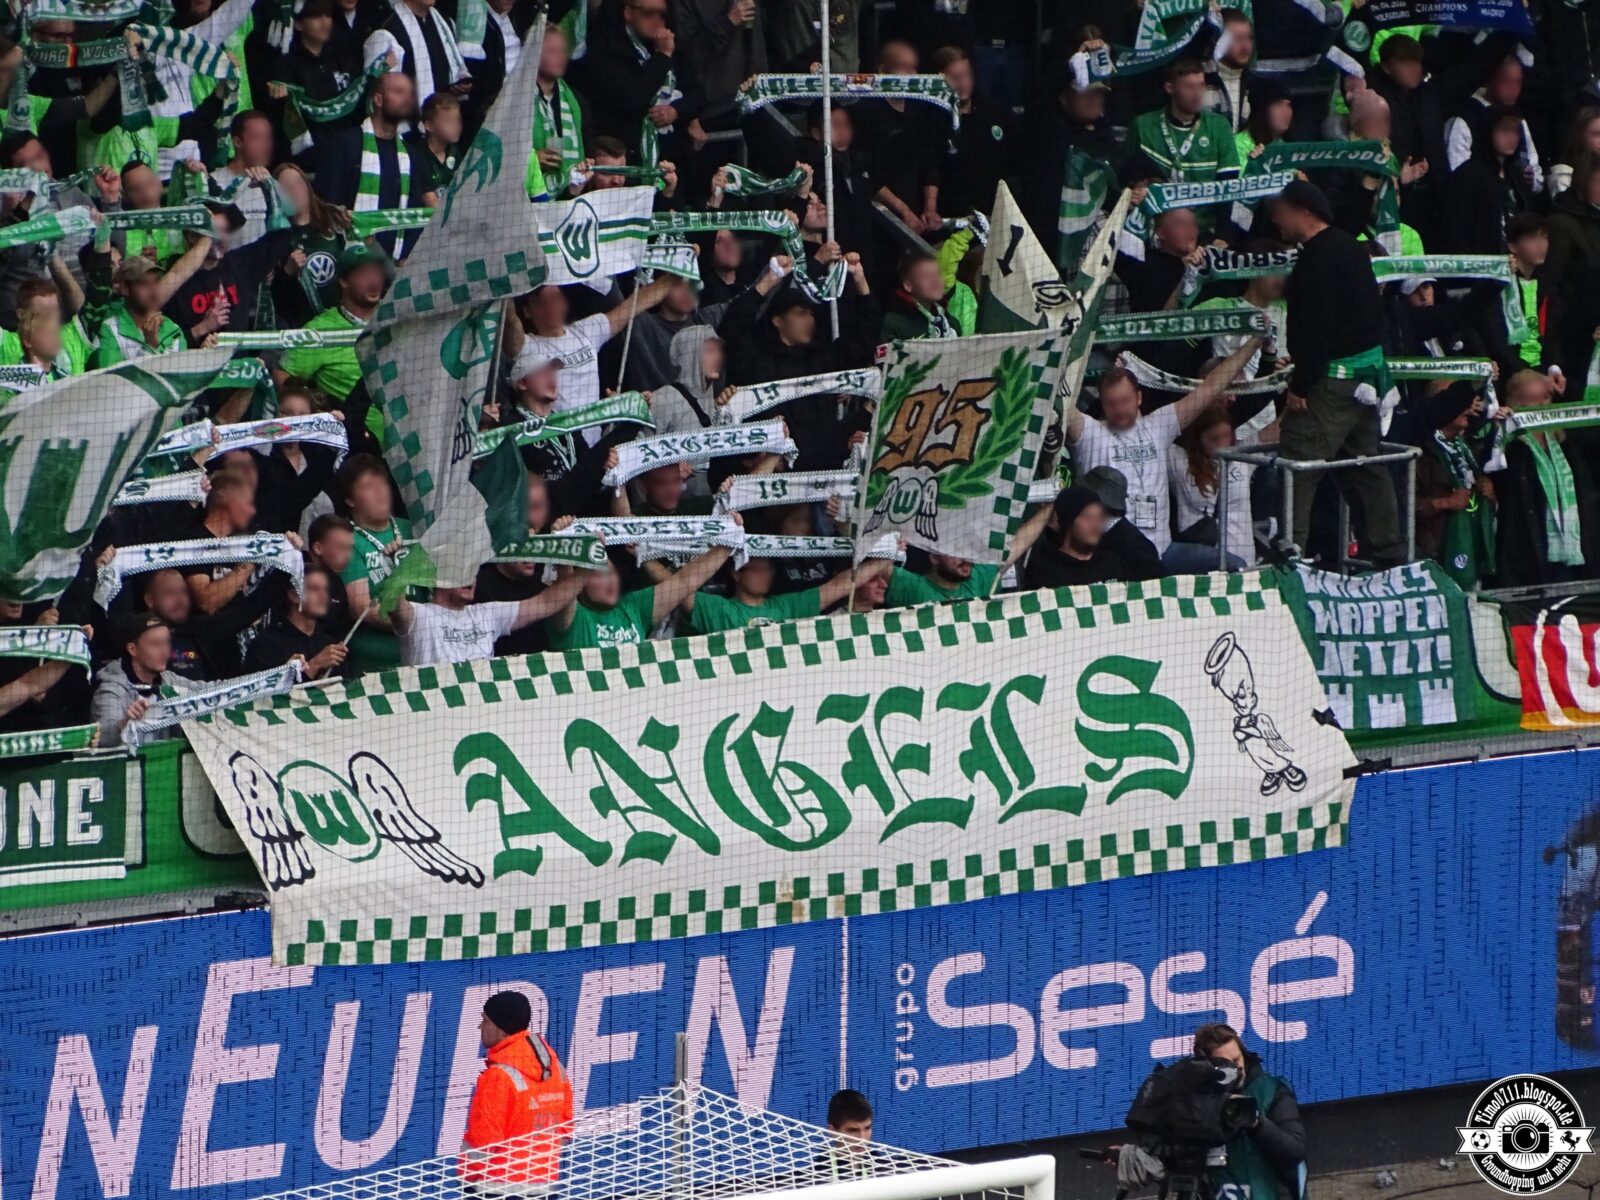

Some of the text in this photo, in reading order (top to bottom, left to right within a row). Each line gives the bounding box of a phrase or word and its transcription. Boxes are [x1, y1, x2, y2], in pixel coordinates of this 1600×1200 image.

[640, 428, 769, 465] ANGELS
[870, 377, 998, 474] 95
[573, 520, 726, 537] ANGELS
[1307, 594, 1448, 636] WAPPEN
[1316, 635, 1453, 677] JETZT!
[453, 657, 1196, 877] ANGELS
[0, 777, 104, 850] NE
[896, 964, 919, 1091] grupo
